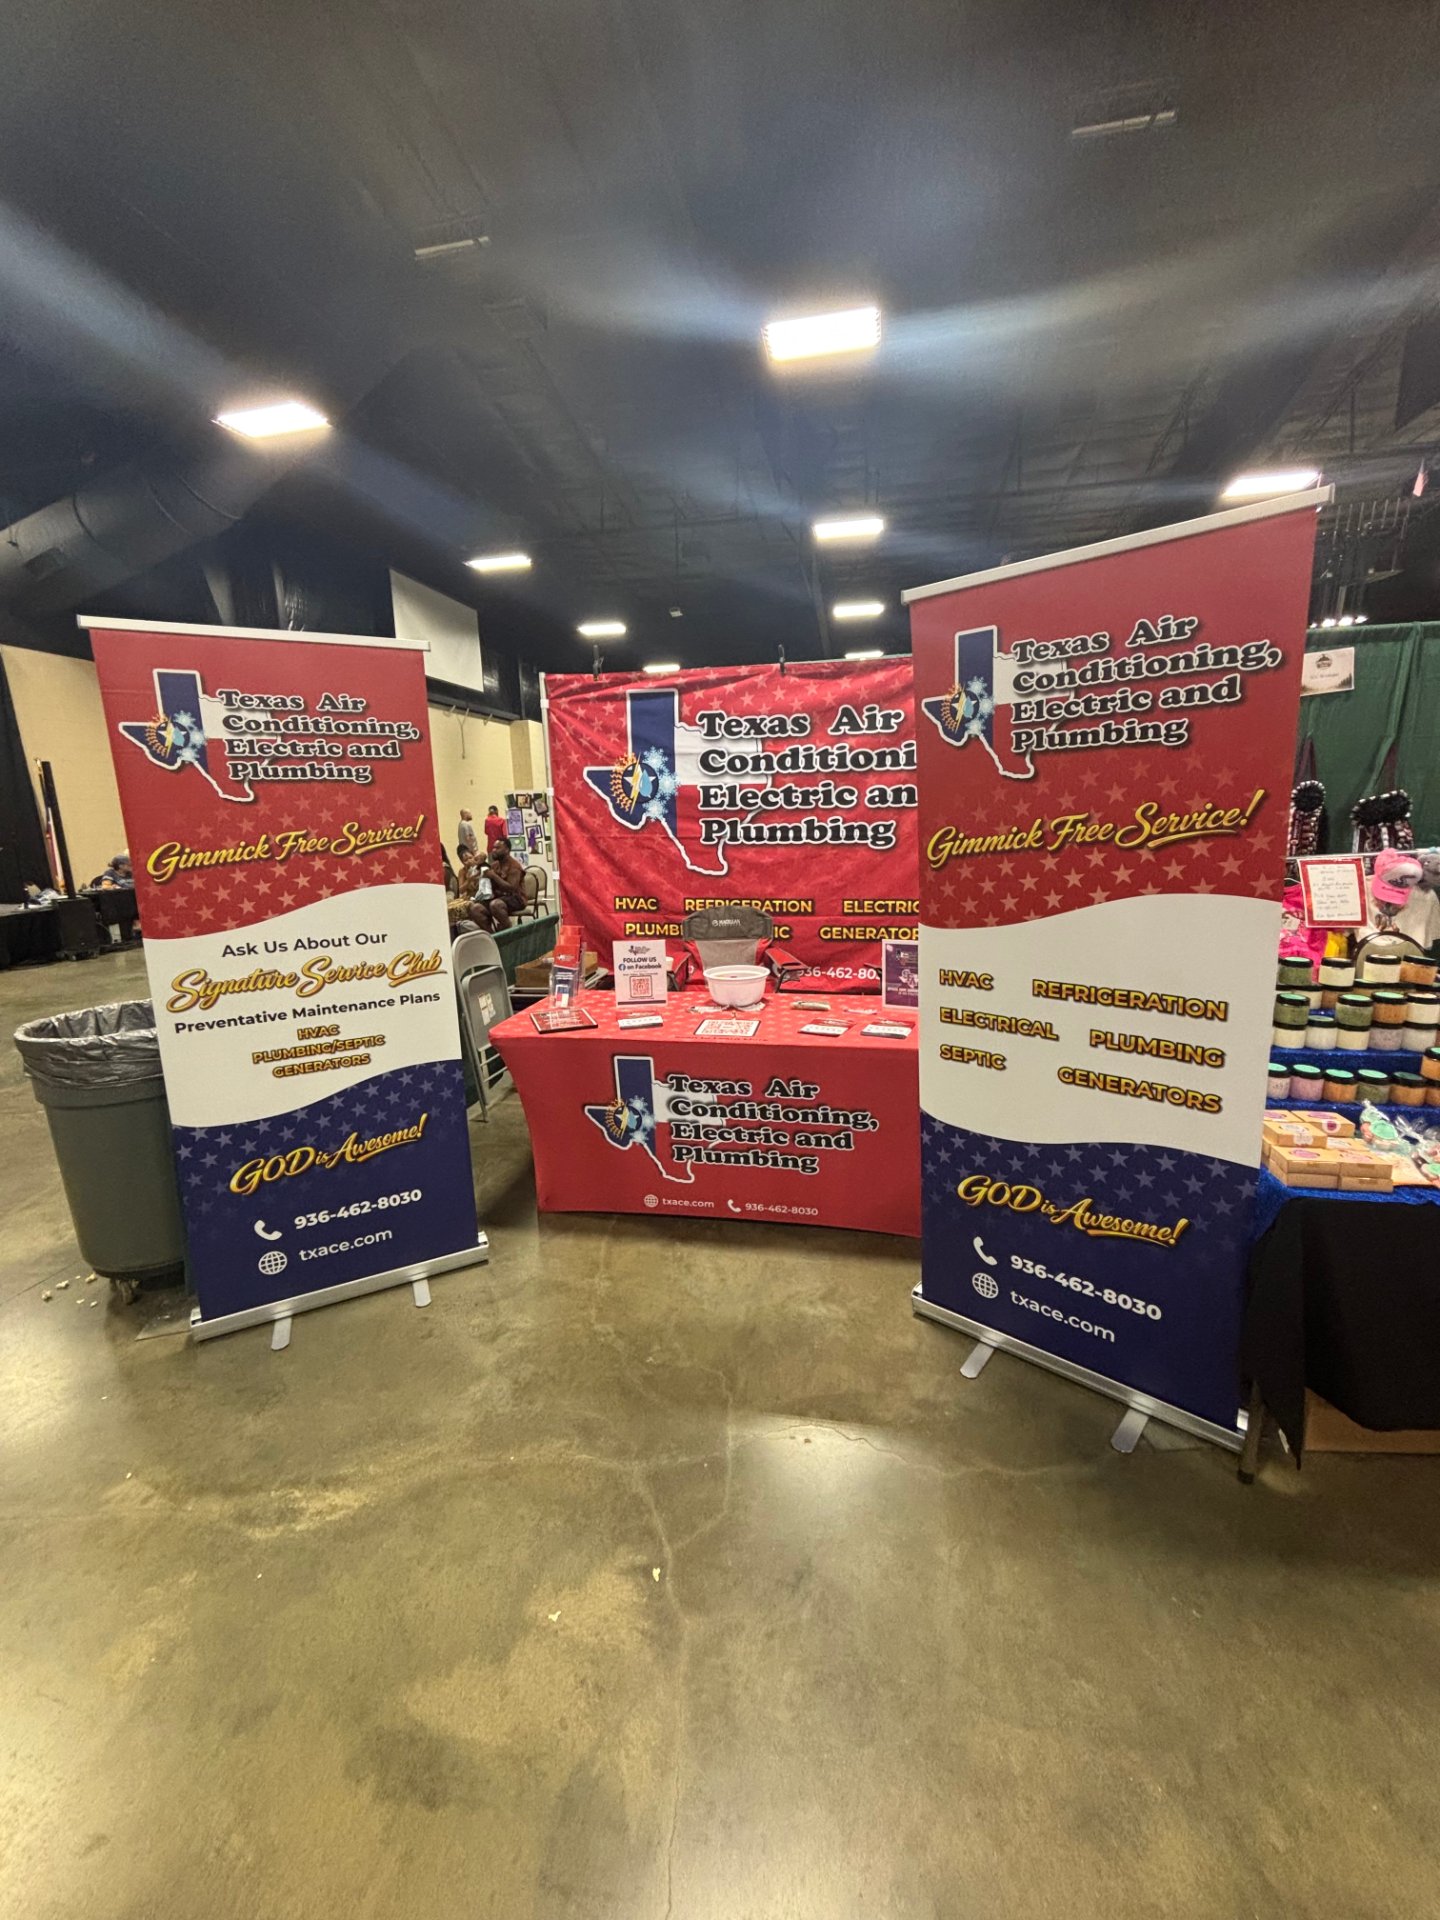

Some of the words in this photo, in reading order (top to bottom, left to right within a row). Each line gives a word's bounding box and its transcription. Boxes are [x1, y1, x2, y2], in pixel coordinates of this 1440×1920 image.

[1011, 632, 1110, 665] Texas
[1127, 614, 1198, 647] Air
[1012, 639, 1283, 693] Conditioning,
[217, 689, 303, 712] Texas
[317, 693, 367, 713] Air
[1011, 687, 1154, 723] Electric
[1161, 673, 1240, 707] and
[222, 714, 419, 739] Conditioning,
[696, 710, 810, 739] Texas
[828, 705, 904, 735] Air
[1011, 718, 1189, 753] Plumbing
[224, 737, 343, 758] Electric
[347, 739, 401, 758] and
[228, 761, 372, 783] Plumbing
[698, 782, 858, 811] Electric
[699, 818, 895, 849] Plumbing
[927, 819, 1045, 869] Gimmick
[1046, 812, 1117, 851] Free
[1115, 789, 1265, 848] Service!
[146, 838, 271, 883] Gimmick
[275, 829, 331, 862] Free
[329, 814, 425, 857] Service!
[615, 897, 657, 910] HVAC
[222, 943, 259, 958] Ask
[264, 939, 289, 954] Us
[293, 936, 350, 952] About
[355, 932, 388, 945] Our
[166, 967, 299, 1012] Signature
[296, 955, 388, 997] Service
[385, 949, 447, 987] Club
[797, 966, 880, 980] 36-462-80
[939, 969, 994, 991] HVAC
[174, 1011, 288, 1034] Preventative
[292, 997, 395, 1019] Maintenance
[399, 991, 441, 1005] Plans
[1032, 979, 1228, 1022] REFRIGERATION
[297, 1024, 340, 1040] HVAC
[939, 1006, 1059, 1041] ELECTRICAL
[252, 1034, 386, 1065] PLUMBING/SEPTIC
[939, 1044, 1006, 1070] SEPTIC
[1090, 1029, 1225, 1067] PLUMBING
[272, 1053, 371, 1078] GENERATORS
[667, 1074, 751, 1096] Texas
[765, 1078, 820, 1099] Air
[1057, 1066, 1223, 1113] GENERATORS
[669, 1099, 880, 1131] Conditioning,
[671, 1122, 789, 1147] Electric
[794, 1130, 855, 1151] and
[228, 1146, 315, 1195] GOD
[314, 1149, 329, 1167] is
[327, 1112, 429, 1166] Awesome!
[673, 1146, 819, 1174] Plumbing
[293, 1188, 423, 1230] 936-462-8030
[661, 1197, 715, 1210] txace.com
[745, 1202, 819, 1217] 936-462-8030
[957, 1175, 1043, 1213] GOD
[1041, 1199, 1056, 1217] is
[1050, 1197, 1191, 1248] Awesome!
[298, 1228, 393, 1262] txace.com
[1010, 1253, 1163, 1321] 936-462-8030
[1010, 1289, 1116, 1343] txace.com
